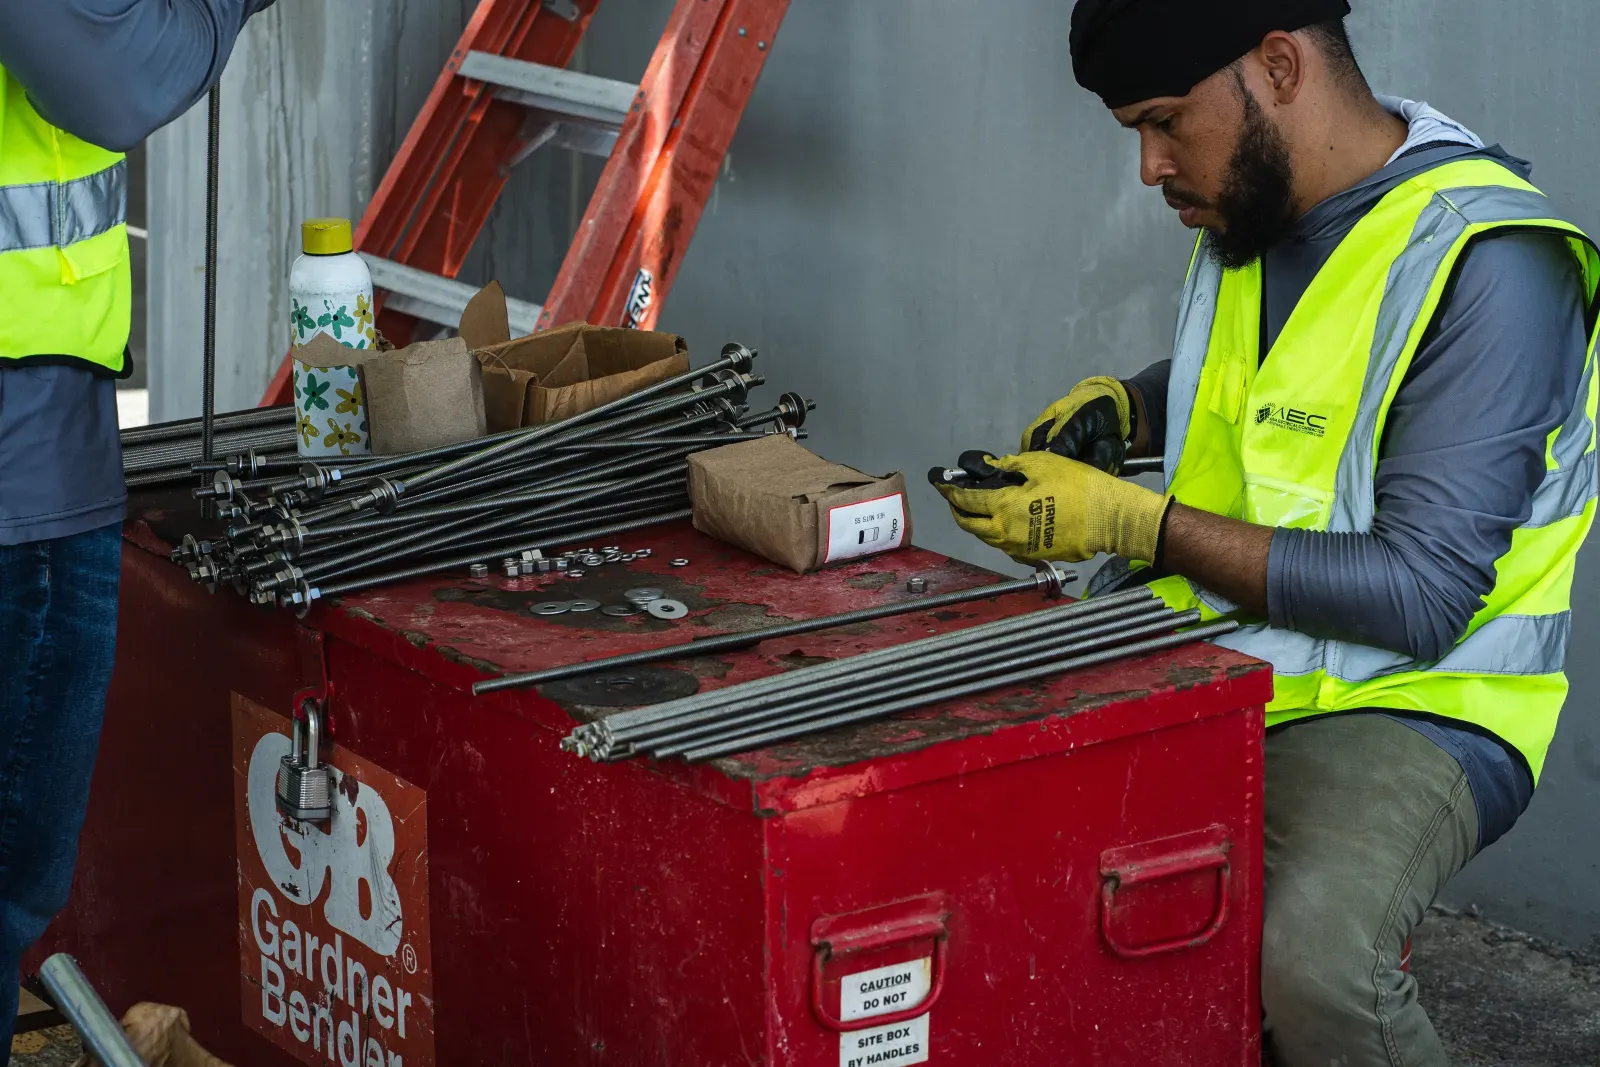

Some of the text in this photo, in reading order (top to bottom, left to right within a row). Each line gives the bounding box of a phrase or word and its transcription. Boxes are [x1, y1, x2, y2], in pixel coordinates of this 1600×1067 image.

[1272, 407, 1327, 429] AEC
[863, 514, 875, 522] NUTS
[1044, 496, 1055, 548] FIRM GRIP
[248, 732, 403, 957] GB
[251, 887, 412, 1040] Gardner
[860, 972, 912, 994] CAUTION
[863, 992, 907, 1011] DO NOT
[858, 1027, 911, 1048] SITE BOX
[848, 1043, 919, 1067] BY HANDLES
